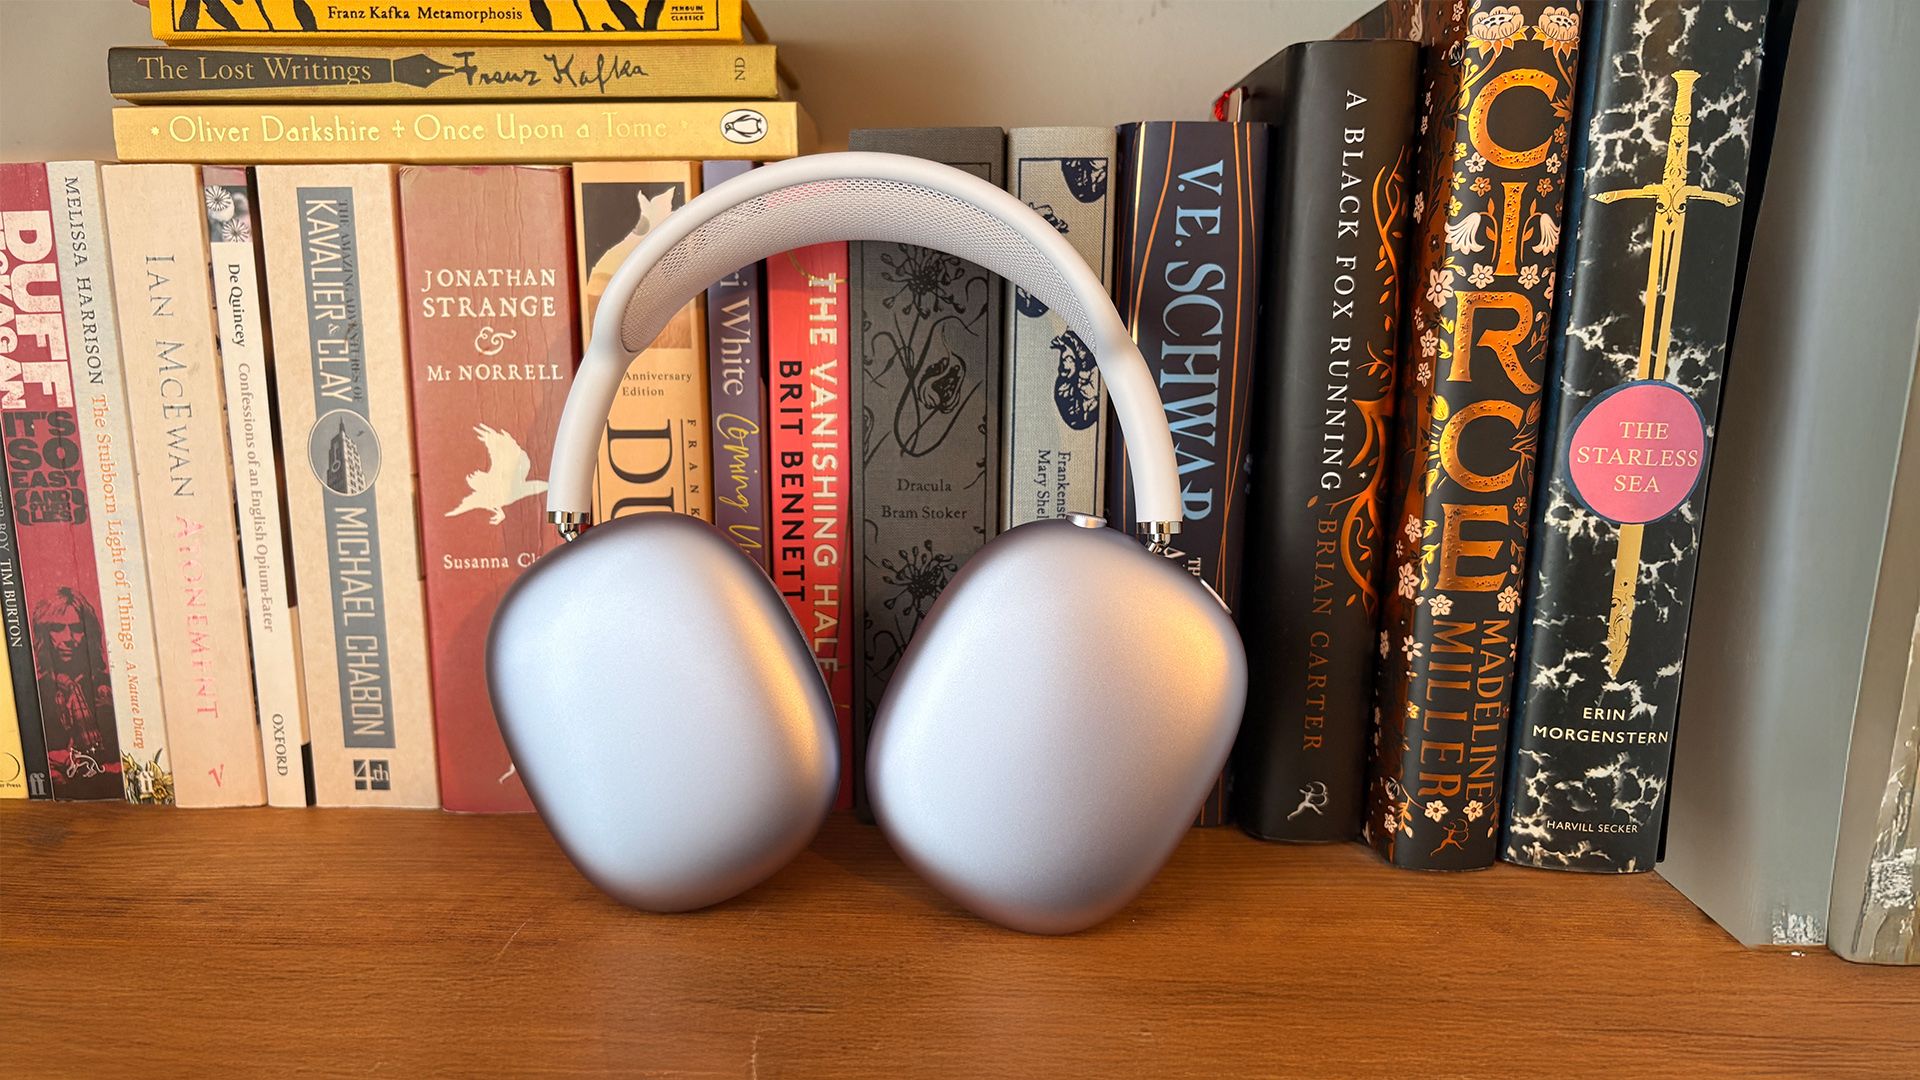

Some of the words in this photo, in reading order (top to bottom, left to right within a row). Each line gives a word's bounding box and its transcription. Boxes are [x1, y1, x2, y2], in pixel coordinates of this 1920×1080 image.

[328, 6, 366, 20] Franz
[369, 6, 411, 20] Kafka
[417, 7, 523, 21] Metamorphosis
[138, 56, 188, 81] The
[197, 57, 255, 81] Lost
[263, 57, 373, 85] Writings
[452, 50, 542, 87] Franz
[544, 53, 649, 93] Kafka
[734, 57, 746, 81] ND
[1345, 89, 1368, 111] A
[169, 113, 250, 143] Oliver
[261, 114, 381, 144] Darkshire
[414, 113, 485, 142] Once
[497, 112, 566, 147] Upon
[576, 123, 591, 140] a
[601, 111, 667, 140] Tome
[1336, 126, 1366, 240] BLACK
[338, 200, 349, 226] THE
[228, 263, 241, 284] De
[305, 199, 346, 321] KAVALIER
[341, 233, 355, 293] AMAZING
[422, 268, 556, 293] JONATHAN
[64, 176, 88, 267] MELISSA
[76, 276, 105, 386] HARRISON
[146, 254, 175, 318] IAN
[1331, 255, 1357, 320] FOX
[3, 210, 74, 408] DUFF
[227, 286, 245, 348] Quincey
[422, 296, 556, 319] STRANGE
[808, 272, 838, 346] THE
[328, 323, 341, 335] &
[346, 297, 362, 383] ADVENTURES
[474, 326, 517, 356] &
[721, 296, 751, 396] White
[1434, 67, 1560, 592] CIRCE
[317, 339, 353, 402] CLAY
[427, 364, 452, 382] Mr
[458, 363, 564, 382] NORRELL
[623, 371, 693, 383] Anniversary
[90, 393, 107, 429] The
[238, 363, 256, 450] Confessions
[353, 386, 364, 402] OF
[622, 386, 665, 397] Edition
[779, 360, 804, 435] BRIT
[2, 410, 76, 438] IT'S
[1320, 336, 1352, 492] RUNNING
[1618, 421, 1669, 440] THE
[8, 437, 80, 471] SO
[96, 433, 118, 514] Stubborn
[247, 452, 261, 467] of
[686, 419, 701, 517] FRANK
[716, 413, 759, 513] Coming
[809, 358, 838, 568] VANISHING
[1033, 449, 1051, 487] Mary
[1577, 446, 1698, 467] STARLESS
[11, 469, 81, 489] EASY
[249, 469, 259, 486] an
[897, 478, 952, 493] Dracula
[1613, 475, 1661, 493] SEA
[249, 489, 268, 541] English
[780, 451, 806, 602] BENNETT
[881, 505, 919, 520] Bram
[921, 504, 968, 520] Stoker
[105, 518, 123, 566] Light
[443, 553, 509, 570] Susanna
[0, 558, 15, 587] TIM
[113, 569, 127, 589] of
[334, 506, 377, 626] MICHAEL
[1312, 517, 1338, 616] BRIAN
[254, 543, 273, 633] Opium-Eater
[4, 590, 23, 648] BURTON
[116, 592, 135, 651] Things
[175, 515, 219, 719] ATONEMENT
[813, 584, 838, 672] HALF
[126, 661, 137, 672] A
[345, 634, 386, 737] CHABON
[127, 675, 142, 715] Nature
[1302, 631, 1330, 751] CARTER
[1416, 619, 1476, 798] MILLER
[1465, 617, 1510, 801] MADELINE
[132, 717, 145, 749] Diary
[1582, 707, 1626, 721] ERIN
[272, 713, 288, 777] OXFORD
[1532, 725, 1669, 745] MORGENSTERN
[1546, 820, 1594, 833] HARVILL
[1597, 822, 1639, 834] SECKER
